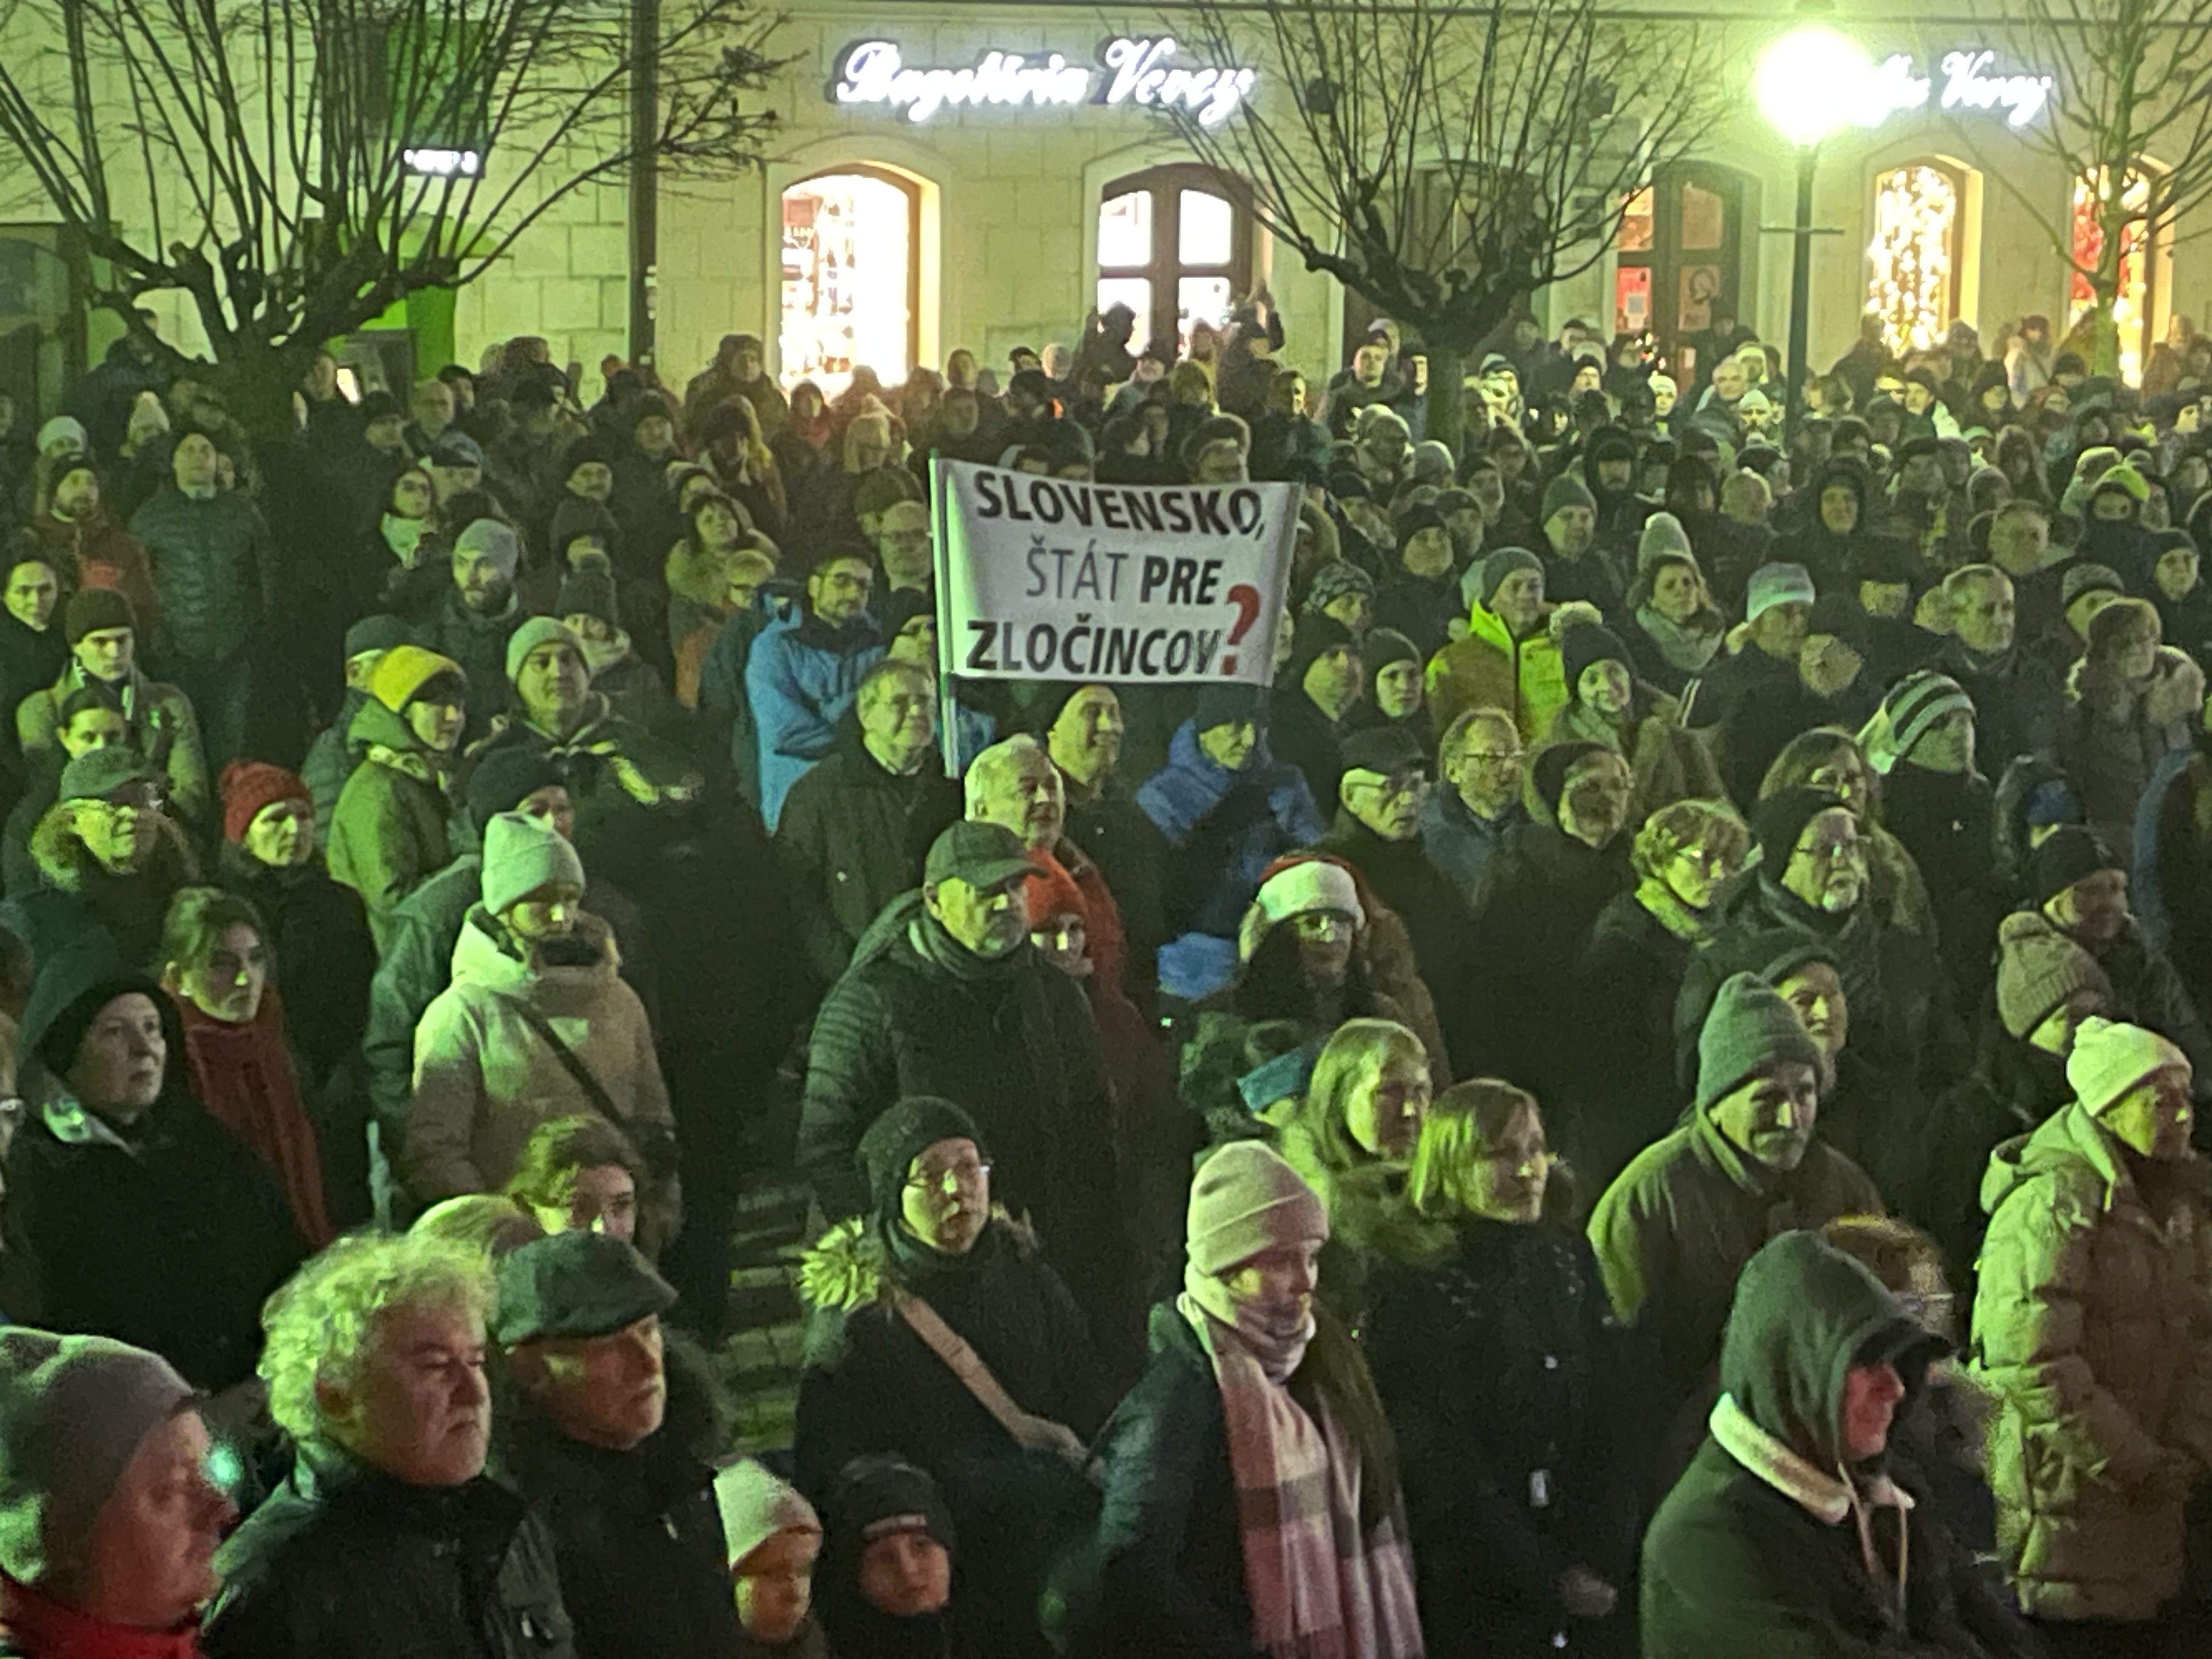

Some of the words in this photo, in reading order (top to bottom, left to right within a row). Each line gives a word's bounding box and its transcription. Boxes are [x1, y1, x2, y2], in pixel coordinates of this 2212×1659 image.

[974, 471, 1264, 541] SLOVENSKO,
[1025, 533, 1129, 601] ŠTÁT
[1140, 555, 1223, 606] PRE
